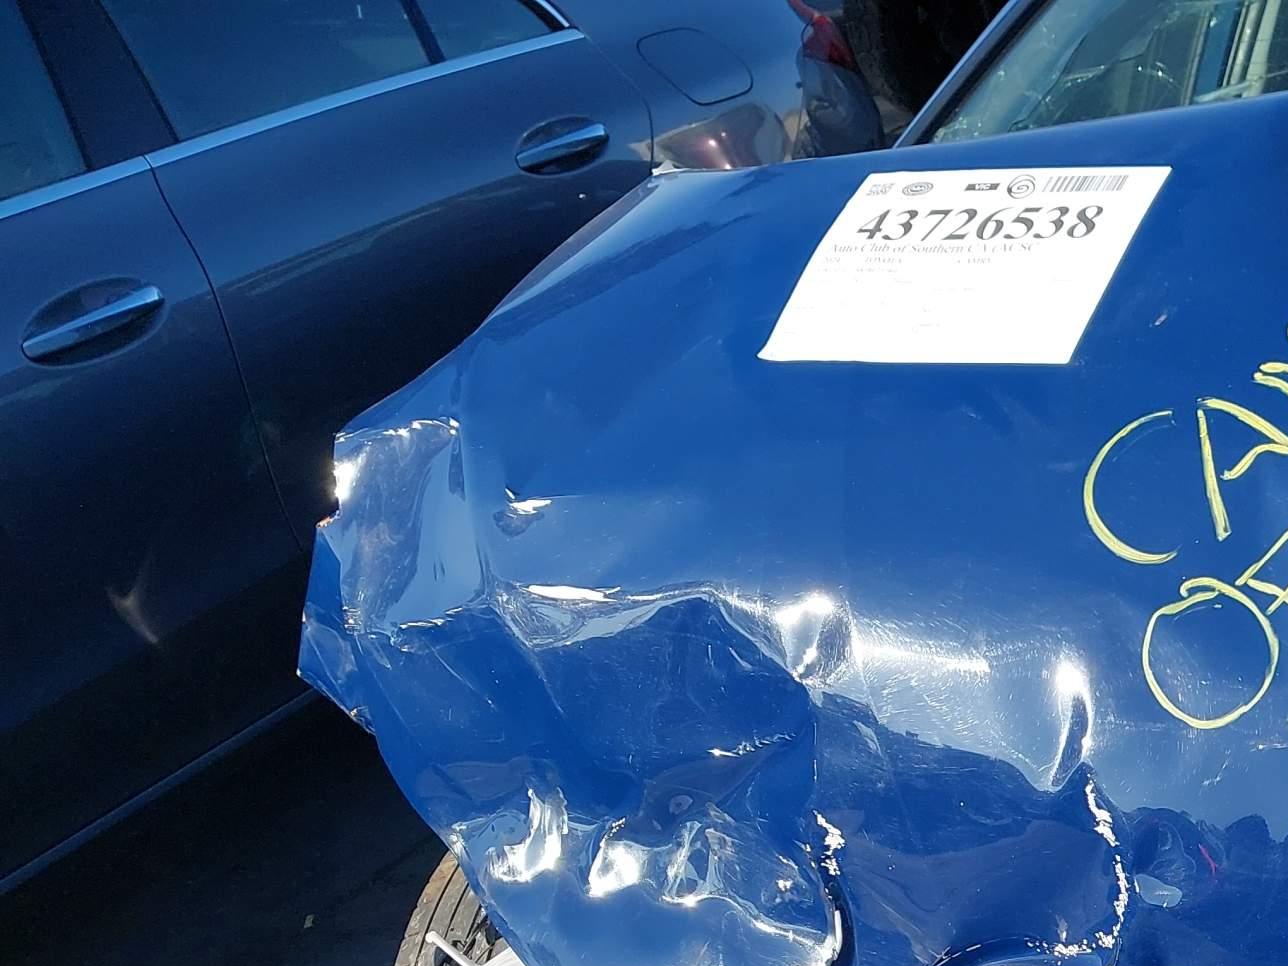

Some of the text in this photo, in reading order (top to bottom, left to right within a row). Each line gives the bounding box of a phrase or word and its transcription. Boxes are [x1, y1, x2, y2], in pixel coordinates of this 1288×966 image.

[857, 205, 1104, 241] 43726538
[861, 243, 891, 253] Club
[911, 243, 966, 256] Southern
